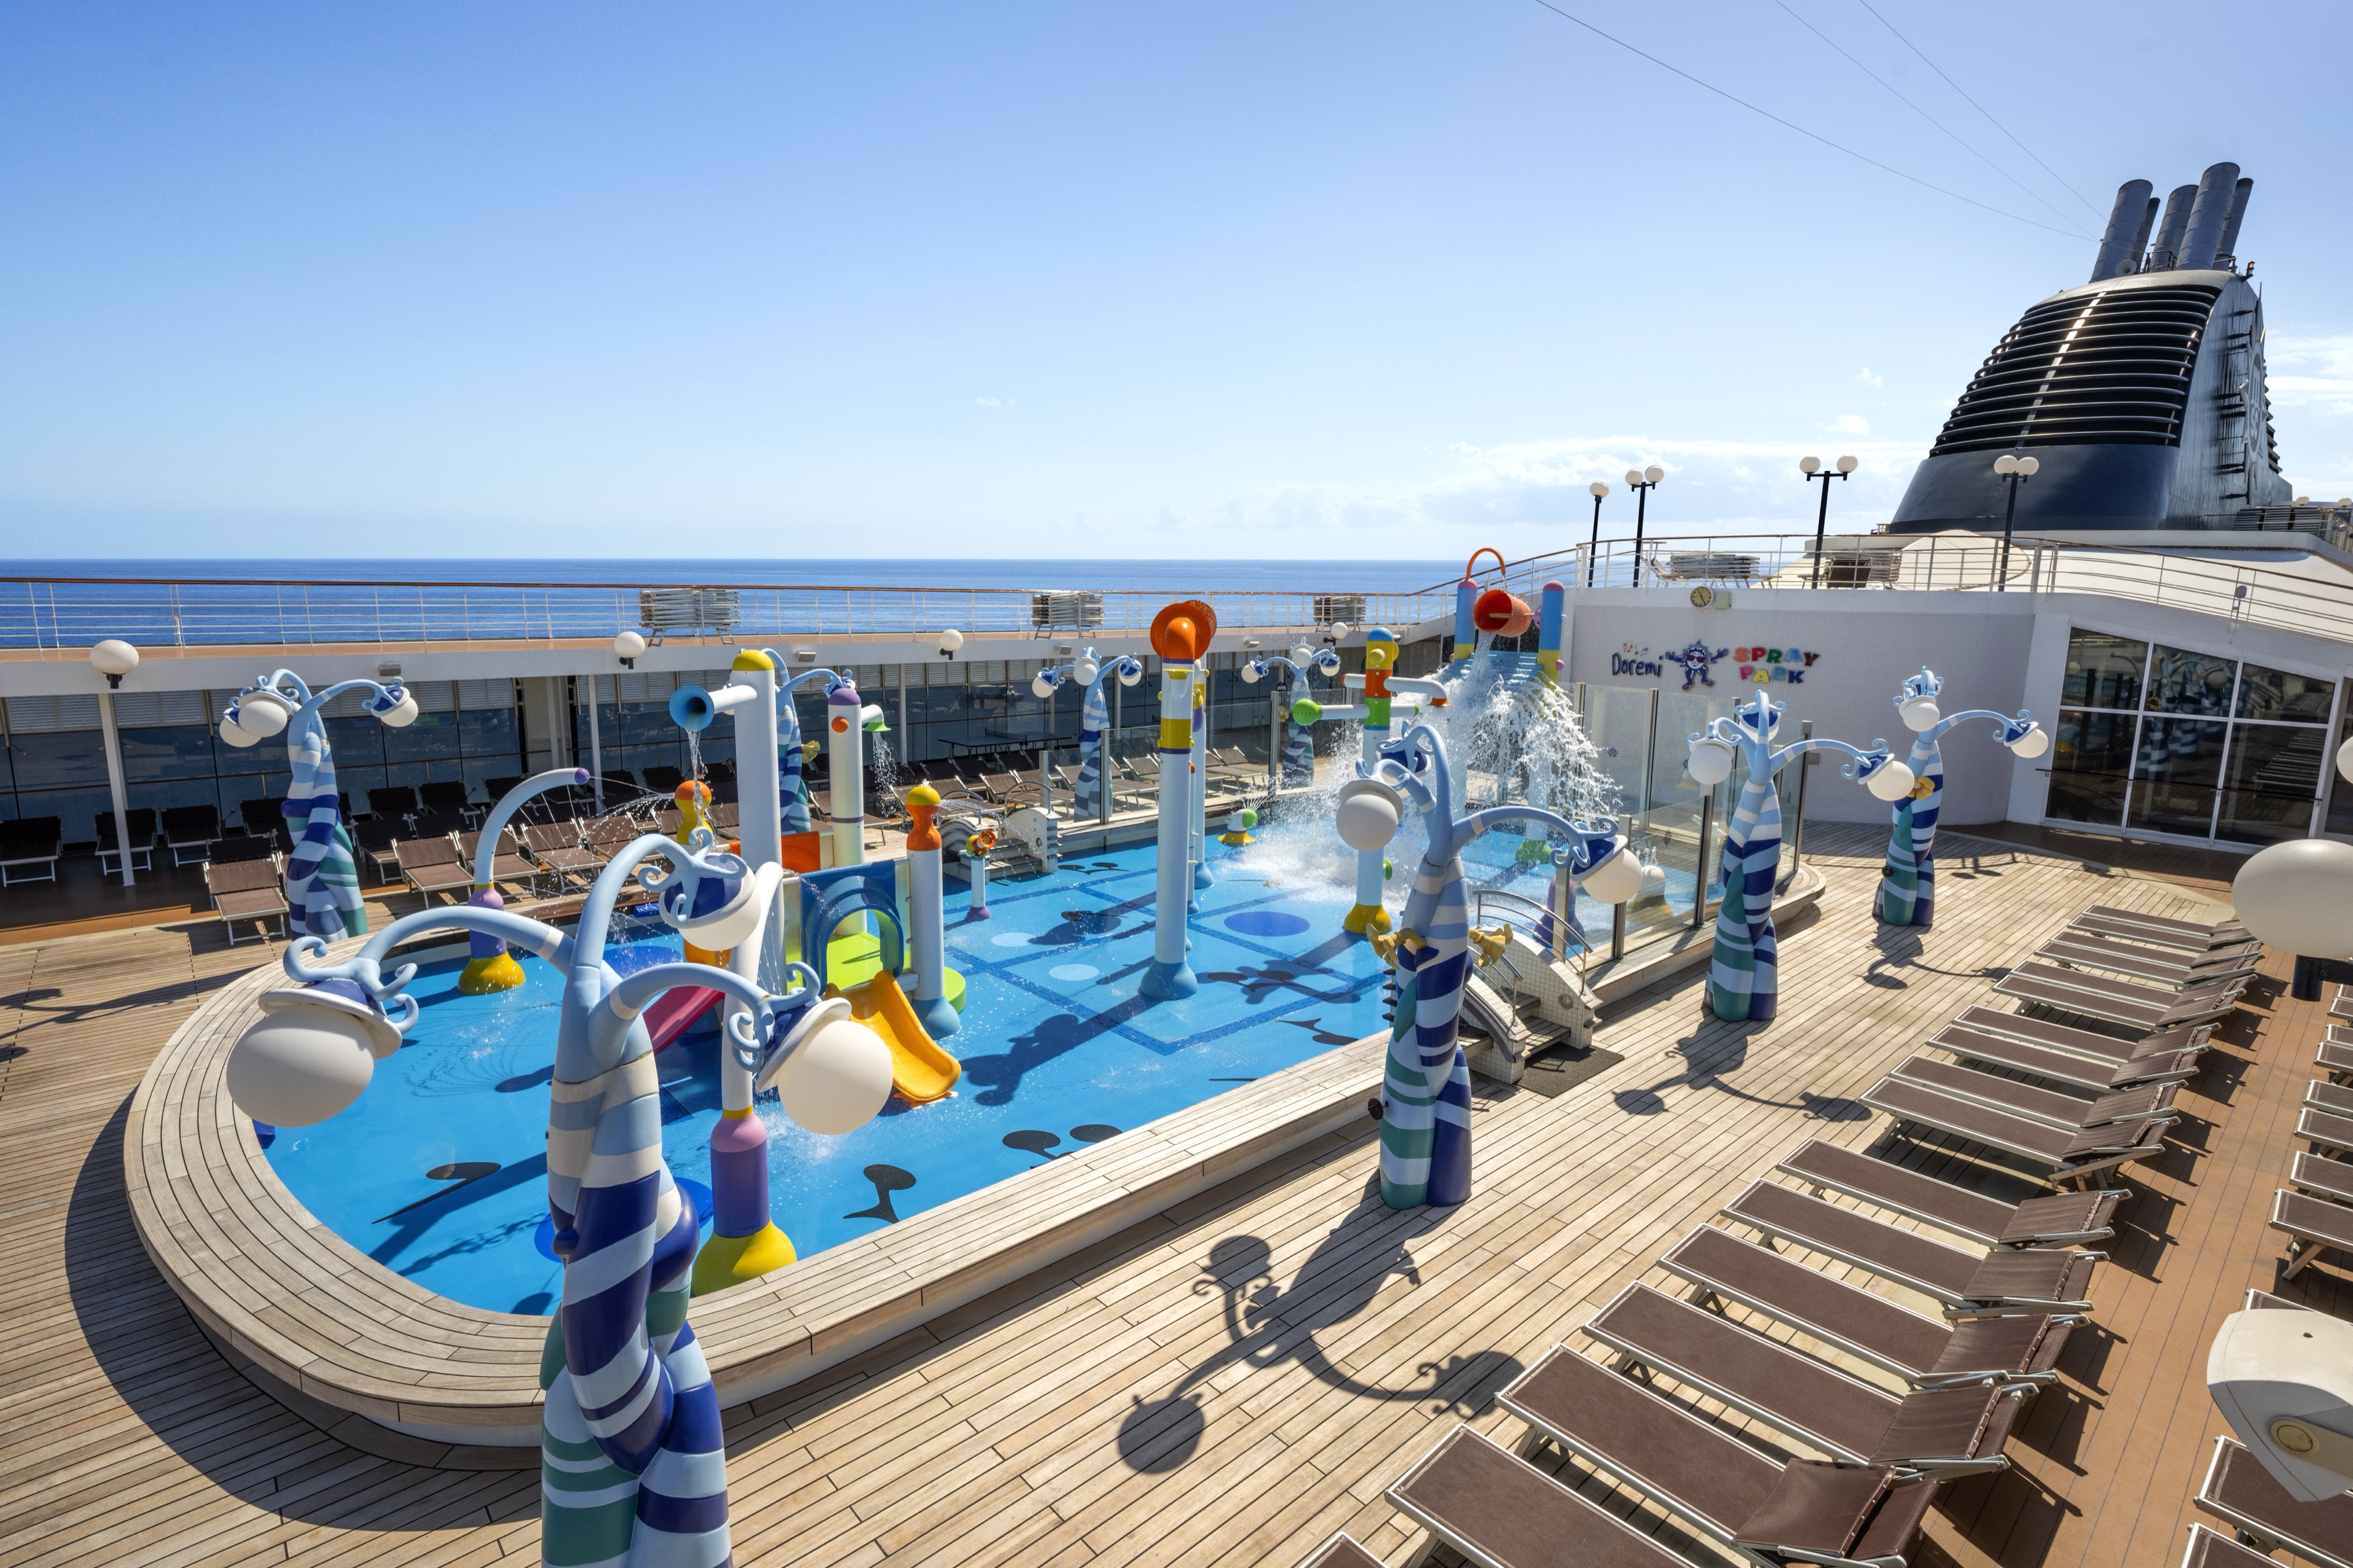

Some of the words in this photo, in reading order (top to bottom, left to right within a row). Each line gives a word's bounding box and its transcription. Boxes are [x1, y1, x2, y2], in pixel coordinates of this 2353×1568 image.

[1612, 652, 1662, 678] Doremi
[1733, 647, 1819, 666] SPRAY
[1739, 665, 1804, 683] PARK
